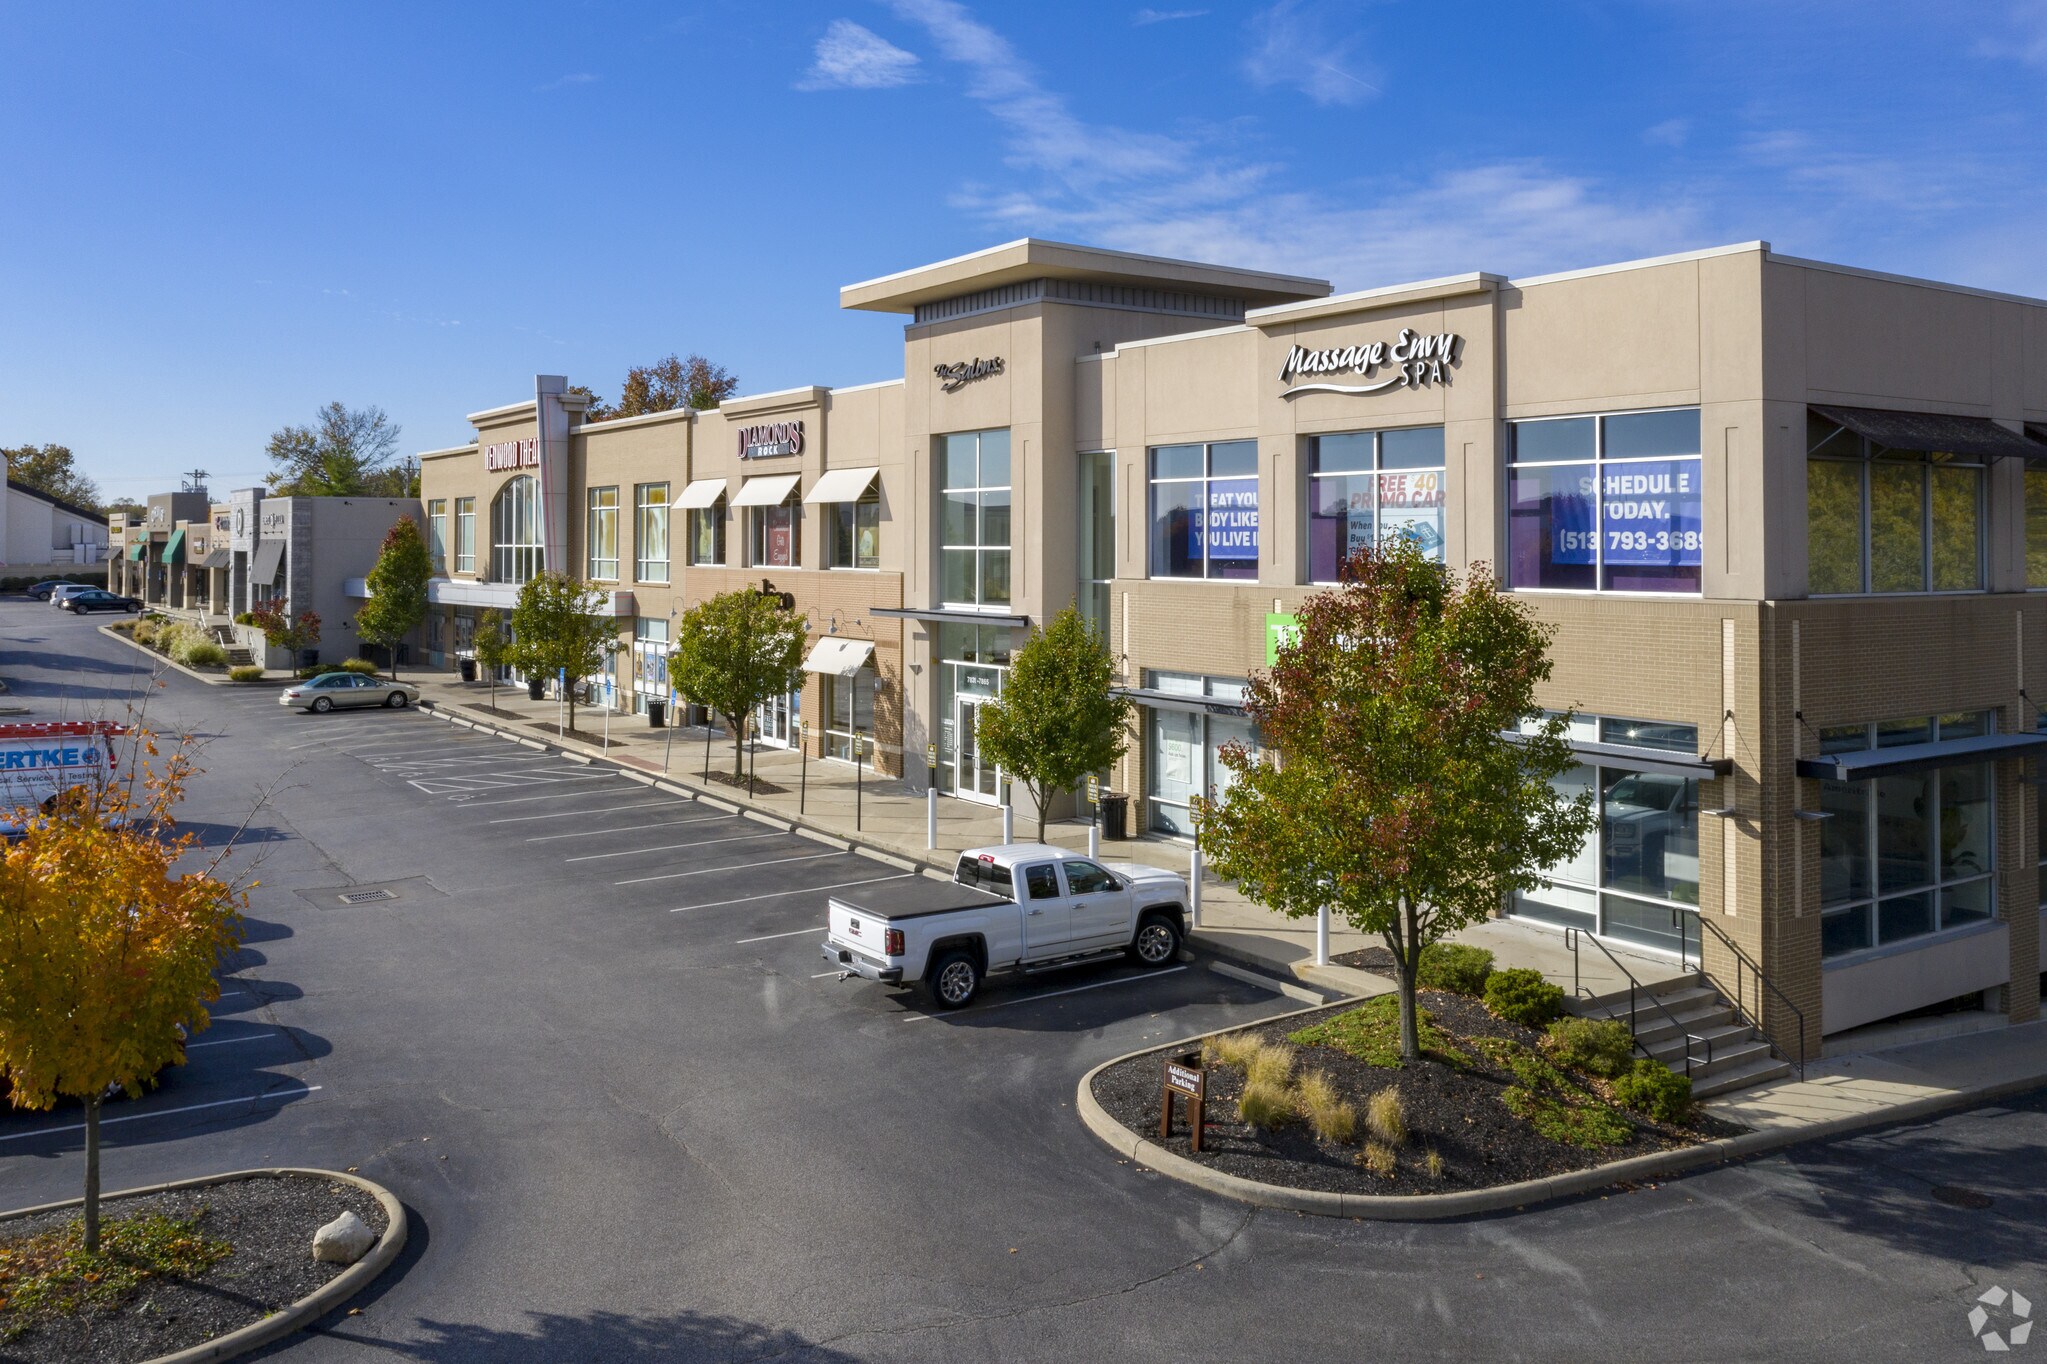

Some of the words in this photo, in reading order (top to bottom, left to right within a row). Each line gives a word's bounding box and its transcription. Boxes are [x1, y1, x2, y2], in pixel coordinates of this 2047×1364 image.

[1278, 344, 1384, 381] Massage
[1390, 328, 1455, 365] Envy
[941, 356, 1001, 392] Salons
[737, 420, 801, 459] DIAMONDS
[484, 441, 518, 470] KENWOOD
[757, 445, 779, 456] ROCK
[1194, 493, 1234, 508] TEAT
[1194, 511, 1229, 528] BDY
[1230, 511, 1259, 527] LIKE
[1350, 521, 1372, 530] When
[1194, 531, 1221, 547] YU
[1222, 531, 1251, 547] LIVE
[1167, 1065, 1200, 1083] Additional
[1171, 1074, 1196, 1093] Parking
